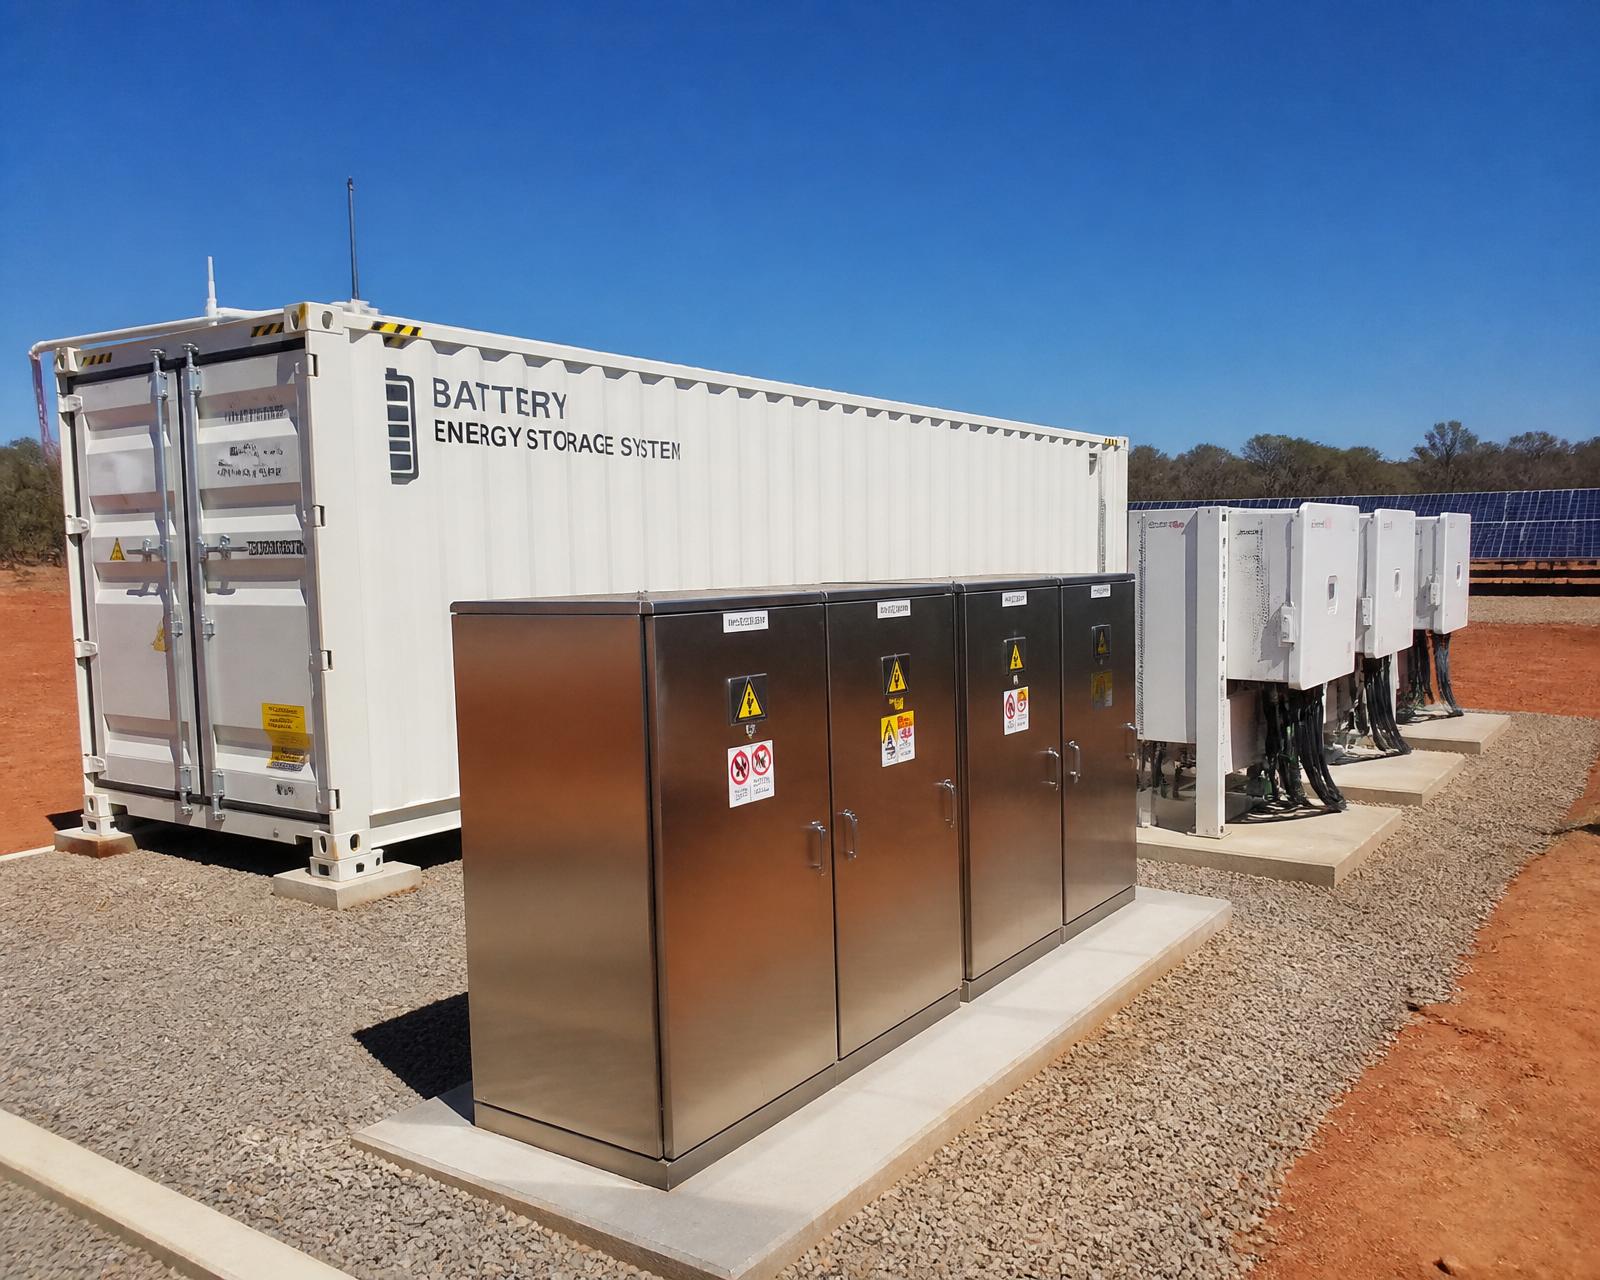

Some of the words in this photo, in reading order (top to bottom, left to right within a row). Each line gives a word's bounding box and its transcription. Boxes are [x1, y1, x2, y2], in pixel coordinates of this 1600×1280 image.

[433, 377, 567, 420] BATTERY
[435, 420, 522, 448] ENERGY
[527, 429, 614, 456] STORAGE
